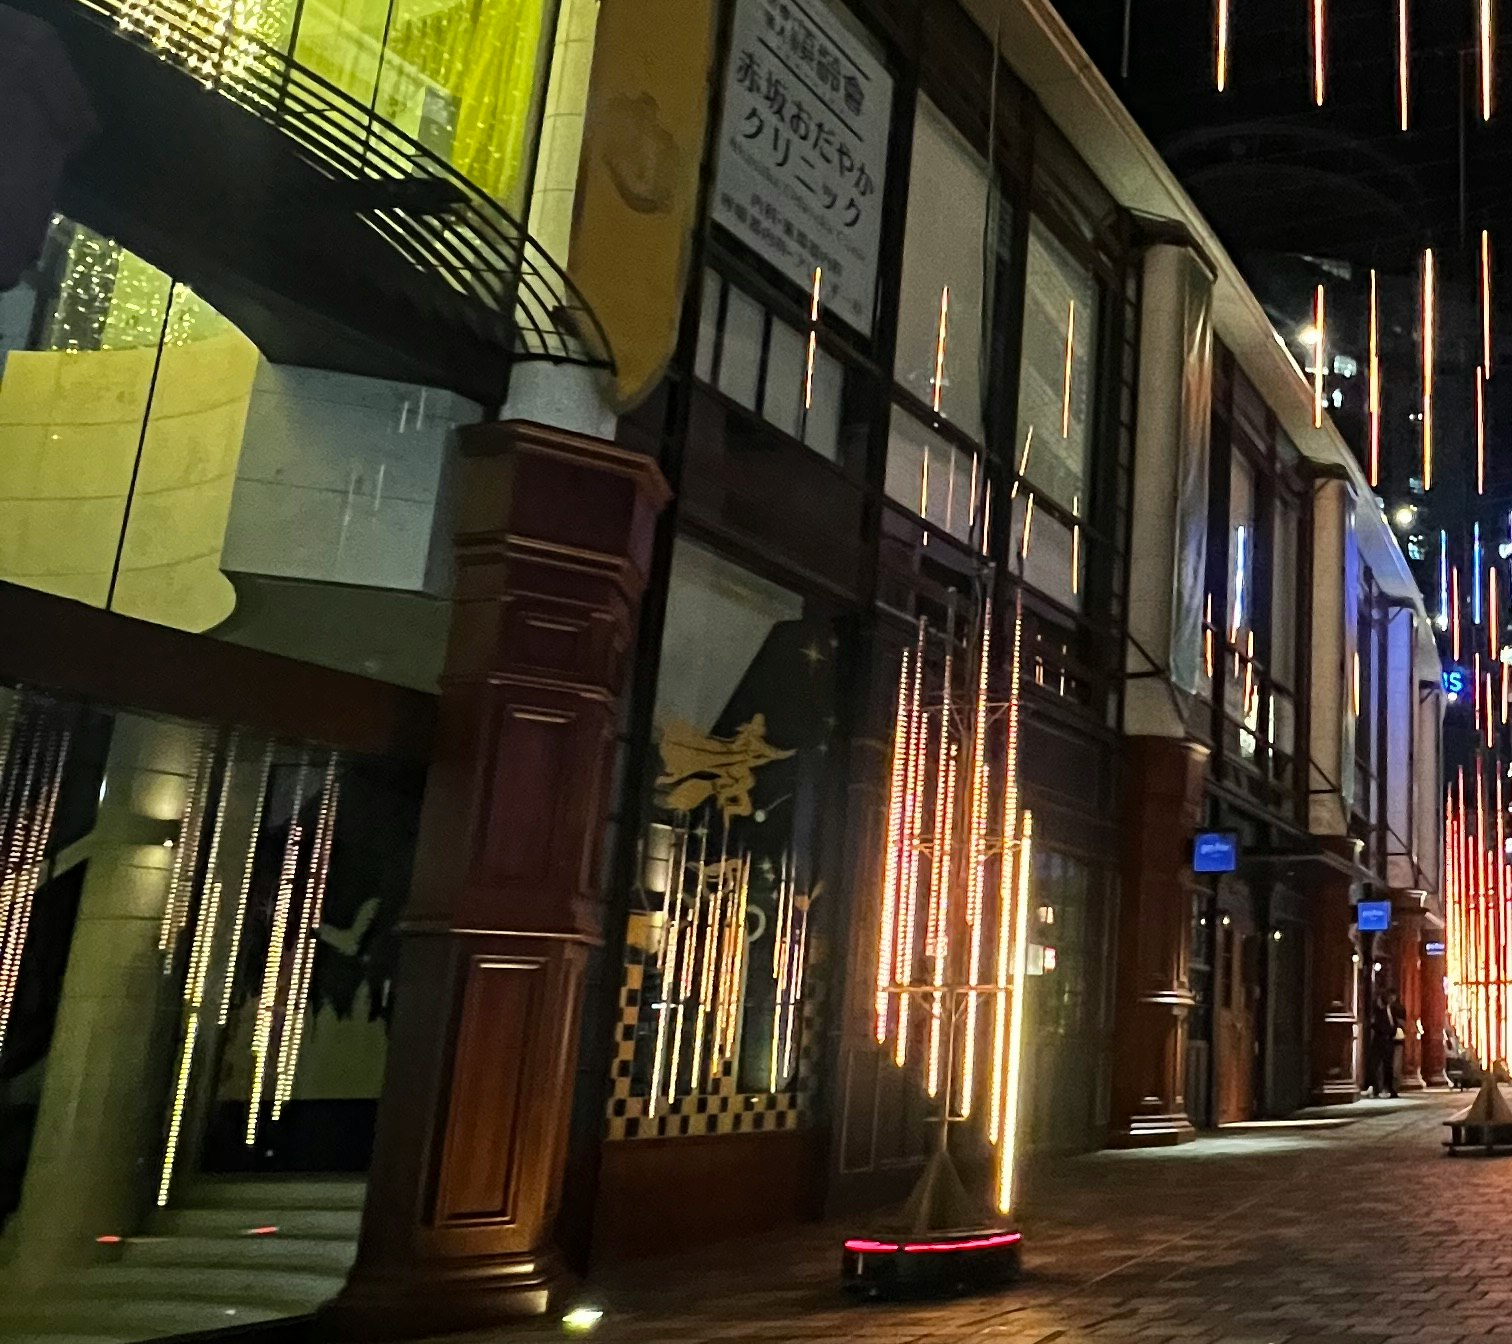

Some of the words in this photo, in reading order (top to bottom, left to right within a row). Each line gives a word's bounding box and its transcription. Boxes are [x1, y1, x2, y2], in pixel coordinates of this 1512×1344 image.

[736, 49, 875, 197] 赤坂おだやか
[742, 107, 862, 228] クリニック
